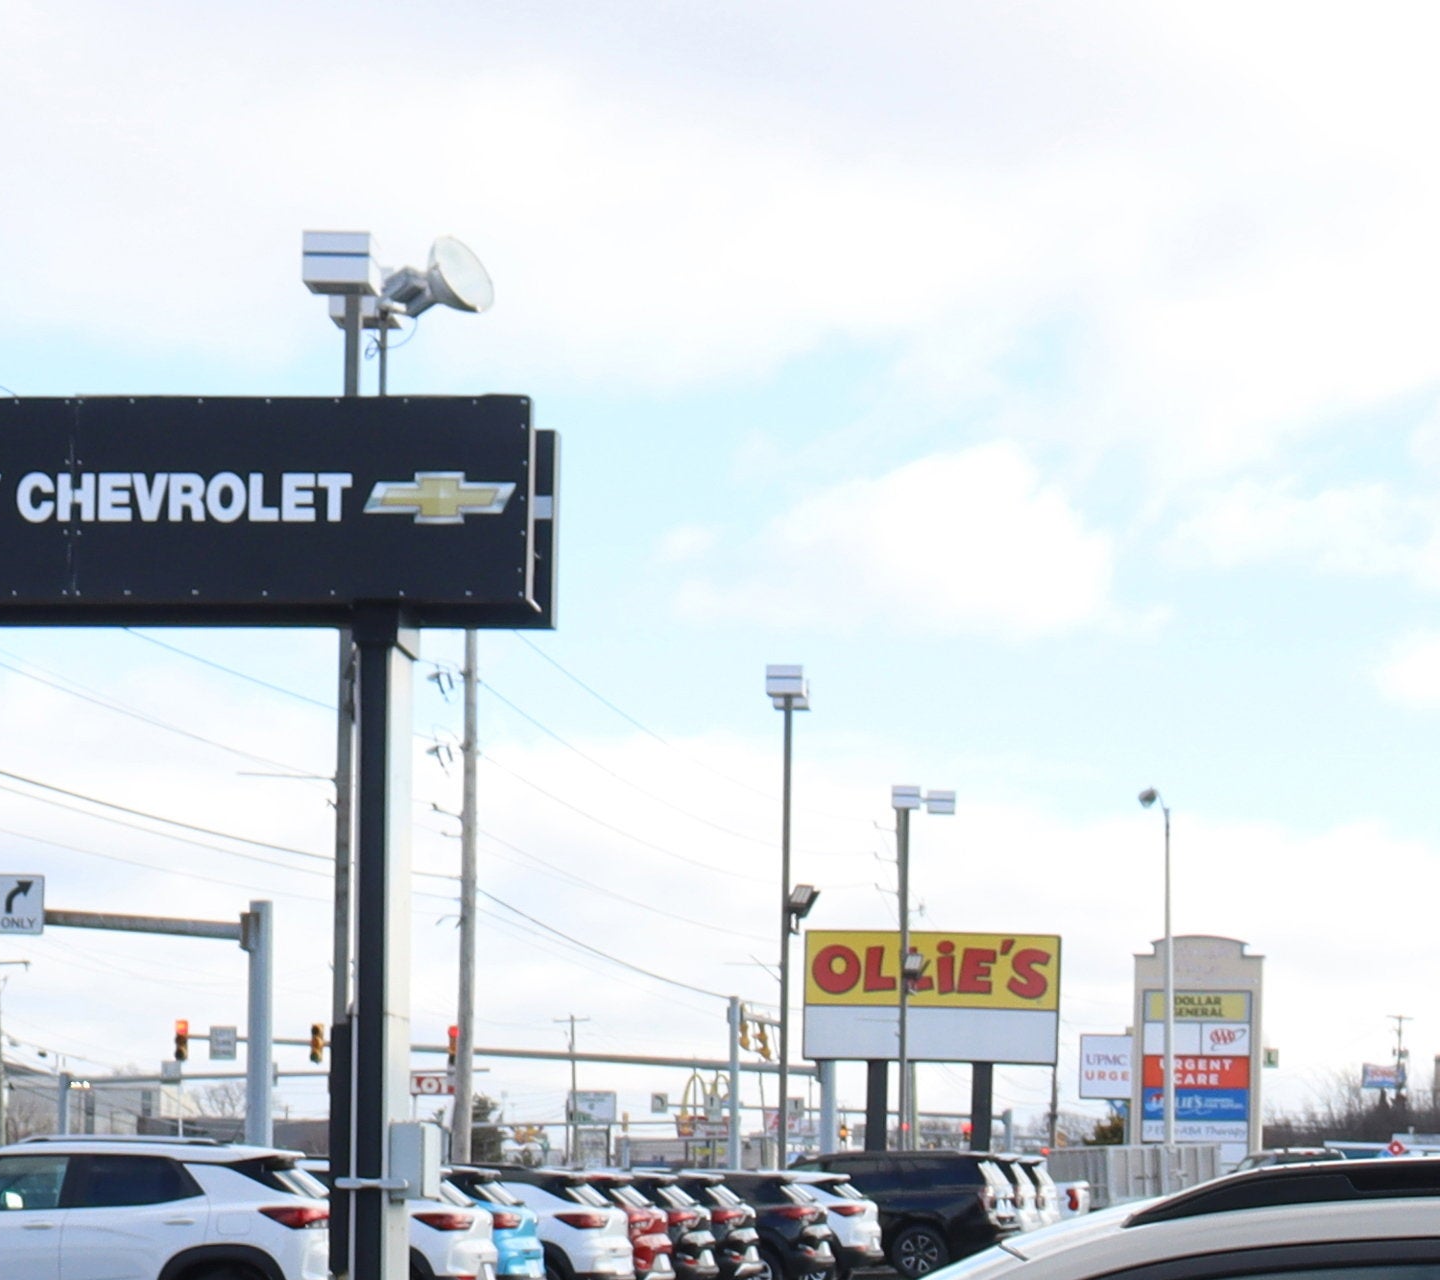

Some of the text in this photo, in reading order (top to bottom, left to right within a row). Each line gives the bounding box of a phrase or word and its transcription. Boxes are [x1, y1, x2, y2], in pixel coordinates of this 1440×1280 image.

[16, 472, 353, 523] CHEVROLET
[0, 916, 36, 930] ONLY
[1175, 995, 1222, 1006] DOLLAR
[1086, 1053, 1128, 1067] UPMC
[1173, 1073, 1220, 1086] CARE
